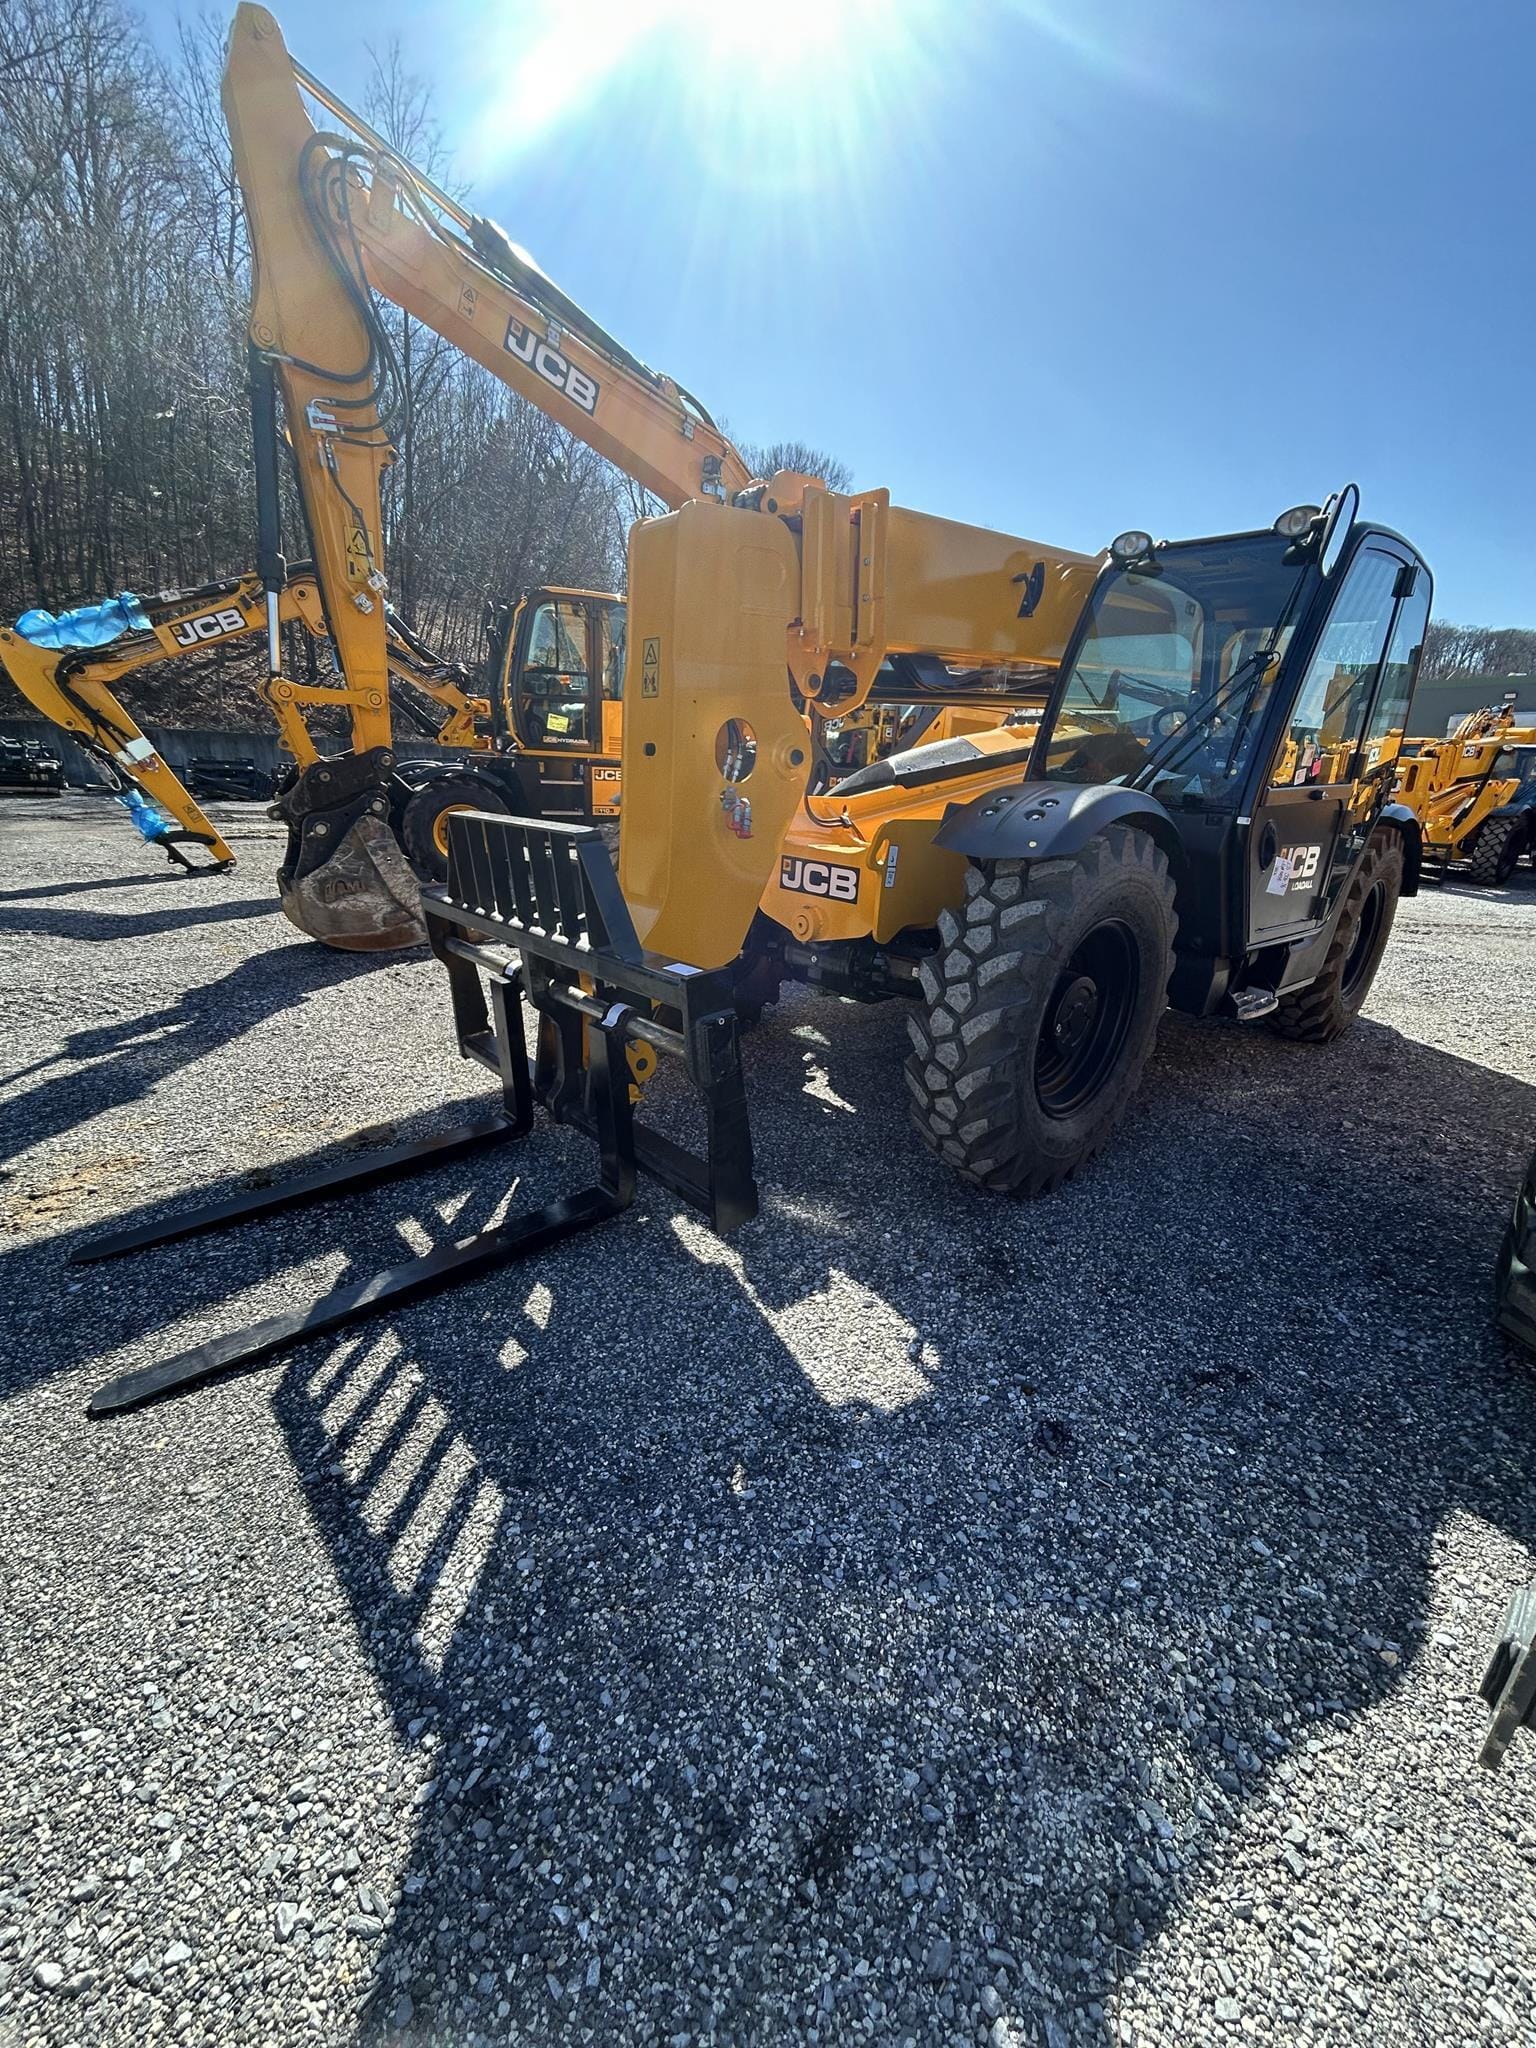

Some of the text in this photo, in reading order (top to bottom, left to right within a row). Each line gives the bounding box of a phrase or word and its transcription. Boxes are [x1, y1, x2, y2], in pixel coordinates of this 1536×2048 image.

[508, 332, 596, 410] JCB
[177, 609, 245, 646] JCB
[782, 861, 857, 900] JCB
